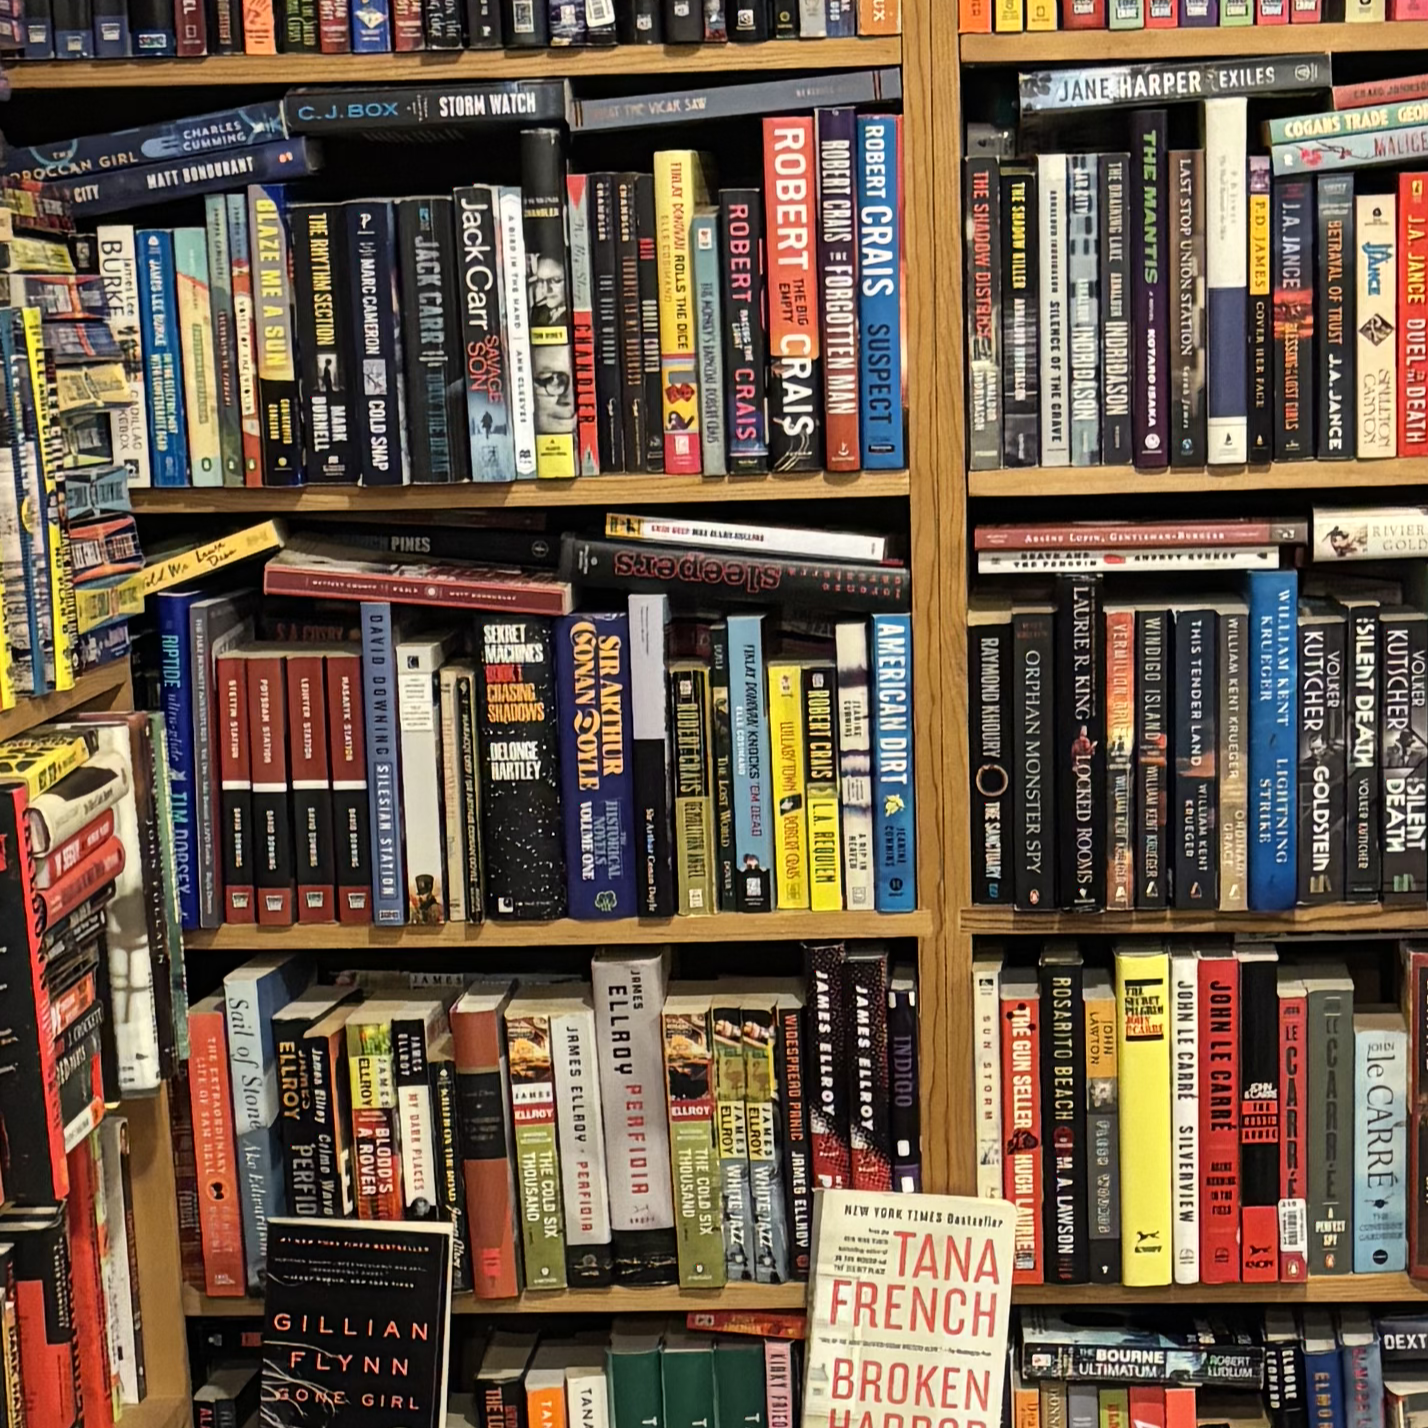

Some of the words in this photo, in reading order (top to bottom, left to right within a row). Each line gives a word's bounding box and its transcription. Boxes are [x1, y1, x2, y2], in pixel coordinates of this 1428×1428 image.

[439, 96, 485, 116] STORM
[489, 93, 535, 114] WATCH
[1059, 77, 1108, 102] JANE
[1120, 71, 1201, 98] HARPER
[1219, 67, 1275, 88] EXILES
[183, 122, 242, 140] CHARLES
[183, 132, 246, 151] CUMMING
[865, 125, 886, 199] ROBERT
[774, 127, 810, 269] ROBERT
[461, 199, 492, 259] Jack
[861, 206, 894, 297] CRAIS
[466, 268, 493, 331] Carr
[780, 333, 815, 437] CRAIS
[868, 323, 890, 425] SUSPECT
[391, 537, 431, 552] PINES
[484, 624, 527, 645] SEKRET
[878, 623, 906, 728] AMERICAN
[1387, 629, 1409, 730] KUTSCHER
[878, 735, 907, 785] DIRT
[1076, 756, 1092, 822] LOCKED
[1179, 1125, 1194, 1222] SILVERVIEW
[844, 1205, 868, 1217] NEW
[875, 1208, 902, 1219] YORK
[908, 1209, 942, 1223] TIMES
[893, 1231, 1000, 1285] TANA
[273, 1313, 430, 1341] GILLIAN
[830, 1279, 996, 1338] FRENCH
[290, 1352, 411, 1376] FLYNN
[832, 1357, 990, 1412] BROKEN
[273, 1391, 351, 1411] GONE
[361, 1391, 421, 1411] GIRL
